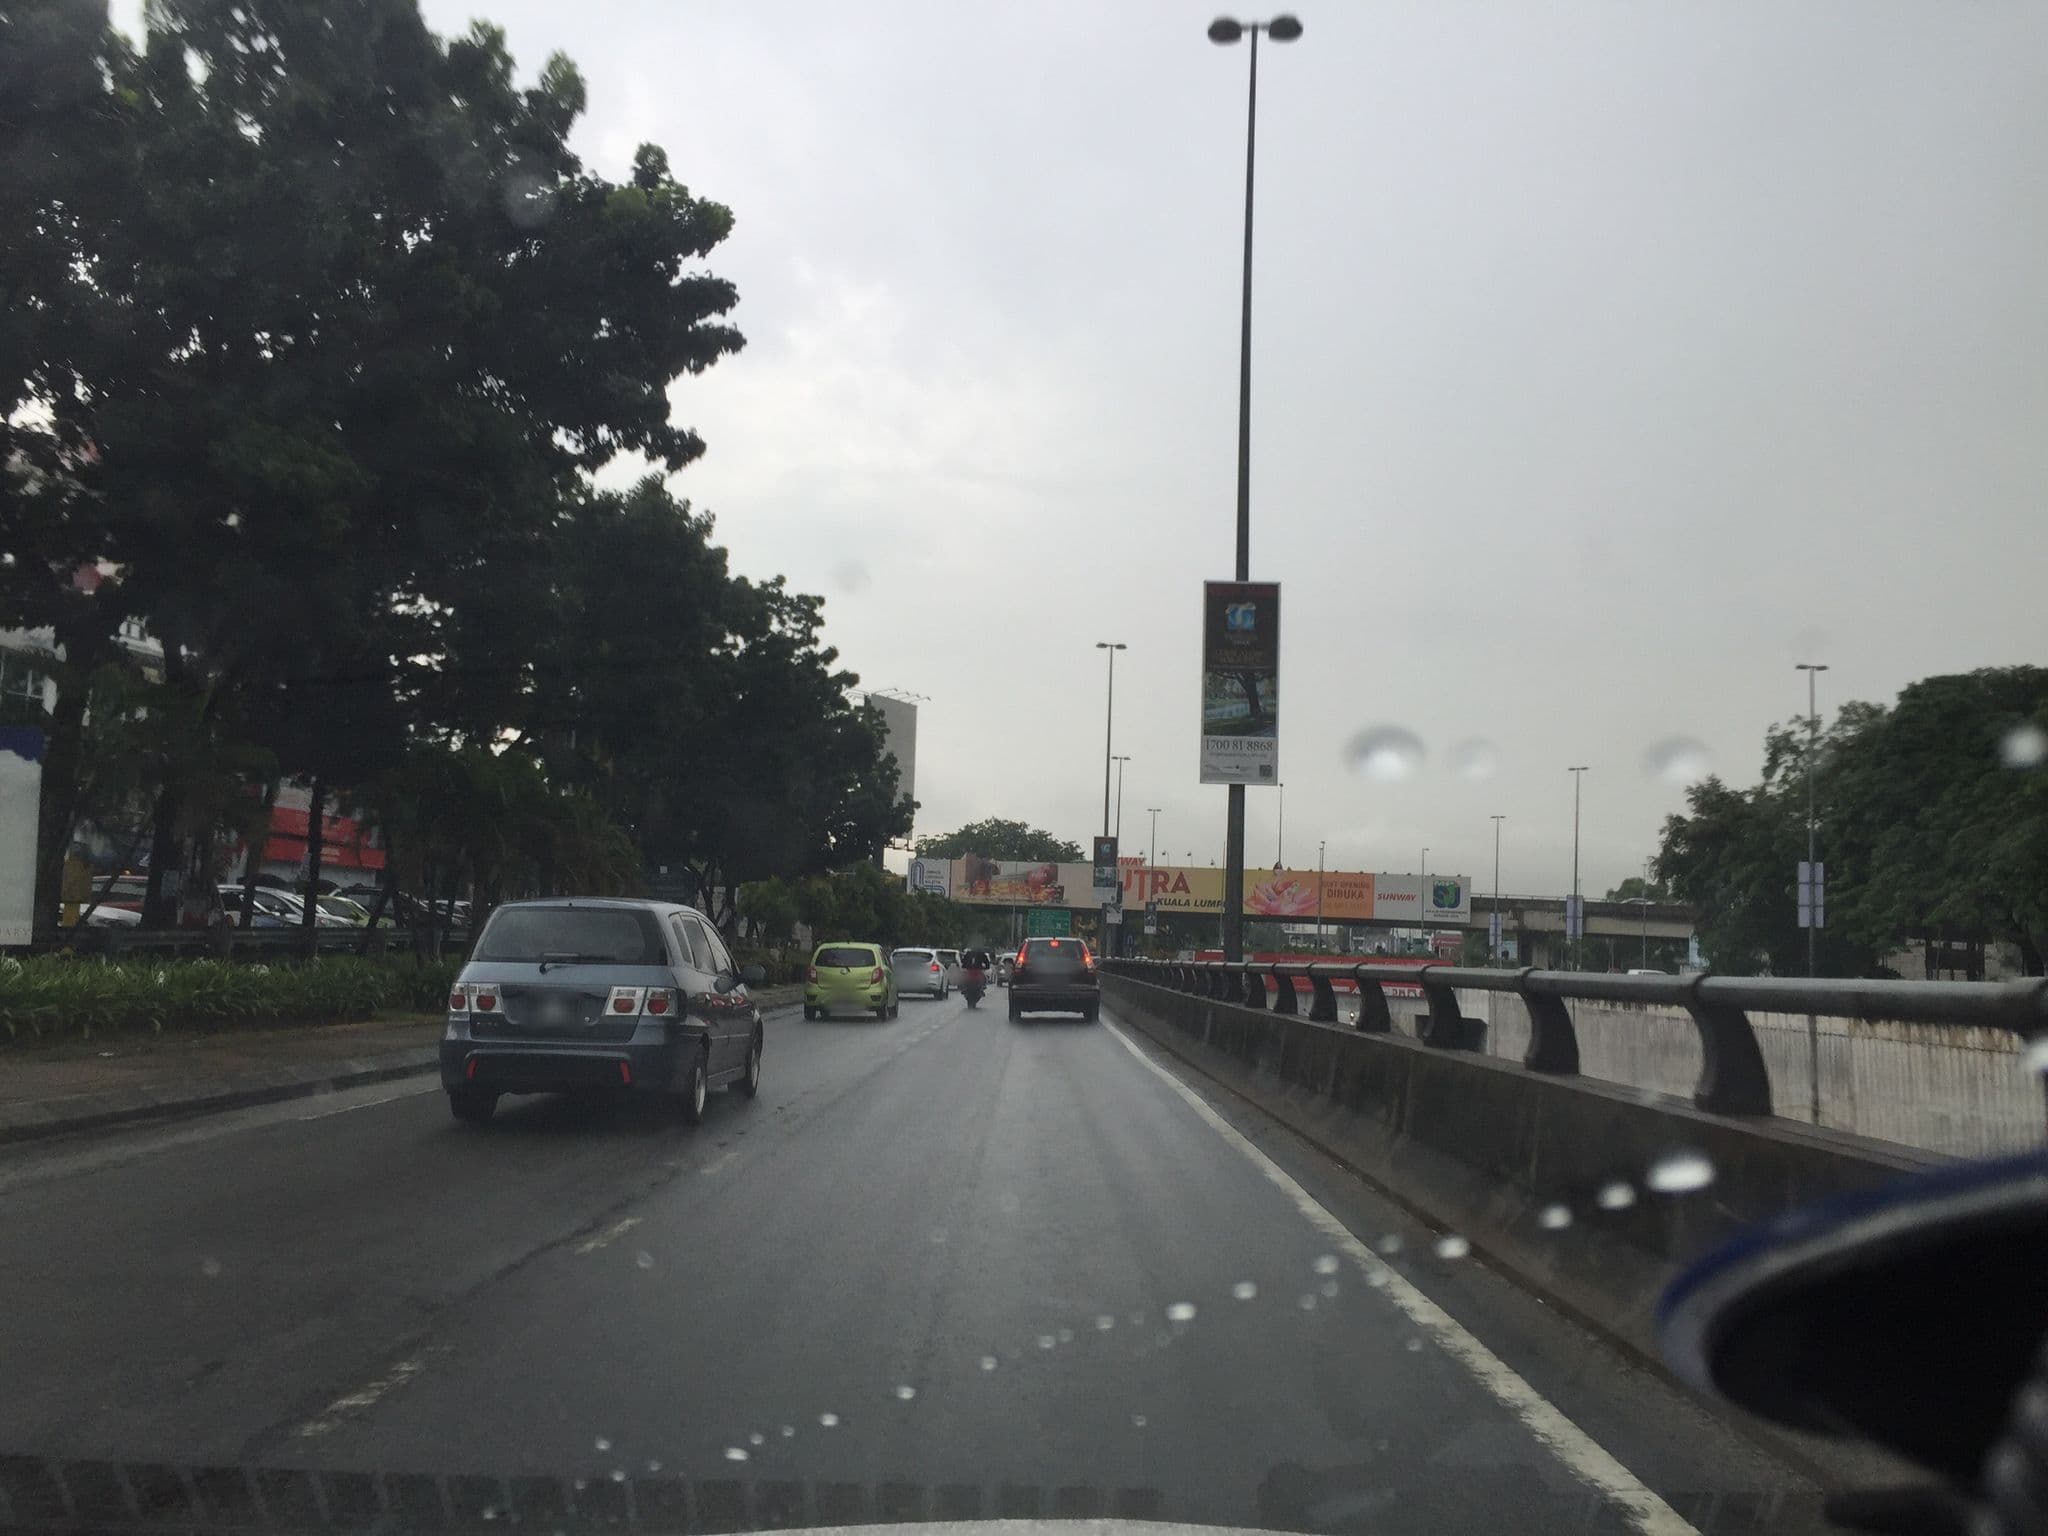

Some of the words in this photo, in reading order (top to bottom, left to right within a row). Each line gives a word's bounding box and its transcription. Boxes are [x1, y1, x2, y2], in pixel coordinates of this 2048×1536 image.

[1206, 740, 1230, 750] 1700
[1232, 740, 1243, 750] 81
[1246, 741, 1273, 751] 8868
[1117, 857, 1147, 866] WAY
[1377, 892, 1417, 902] SUNWAY
[1156, 898, 1191, 907] KUALA
